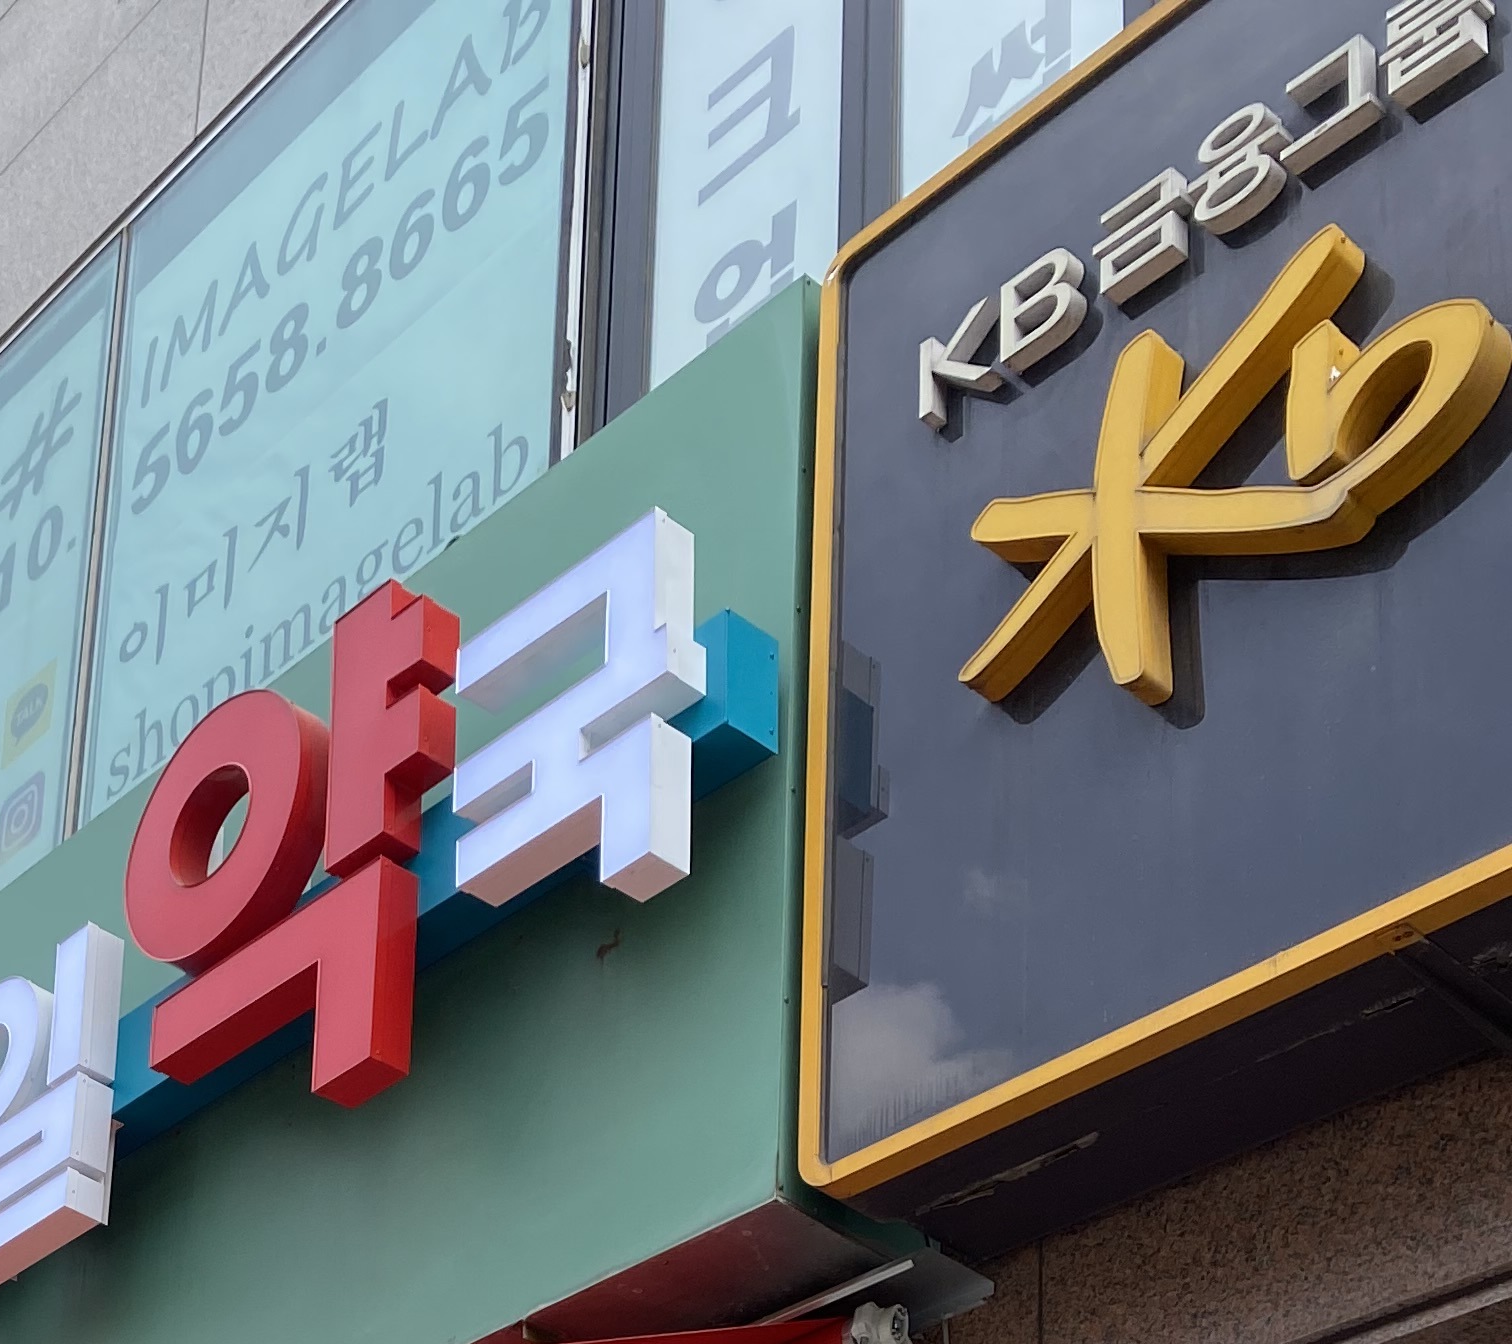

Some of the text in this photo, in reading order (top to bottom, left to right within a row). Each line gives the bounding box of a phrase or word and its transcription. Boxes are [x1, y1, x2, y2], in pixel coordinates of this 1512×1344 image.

[132, 77, 551, 516] 5658.8665
[140, 0, 550, 408] IMAGELAB
[105, 422, 532, 801] shopimagelab
[119, 397, 389, 666] 이미지랩
